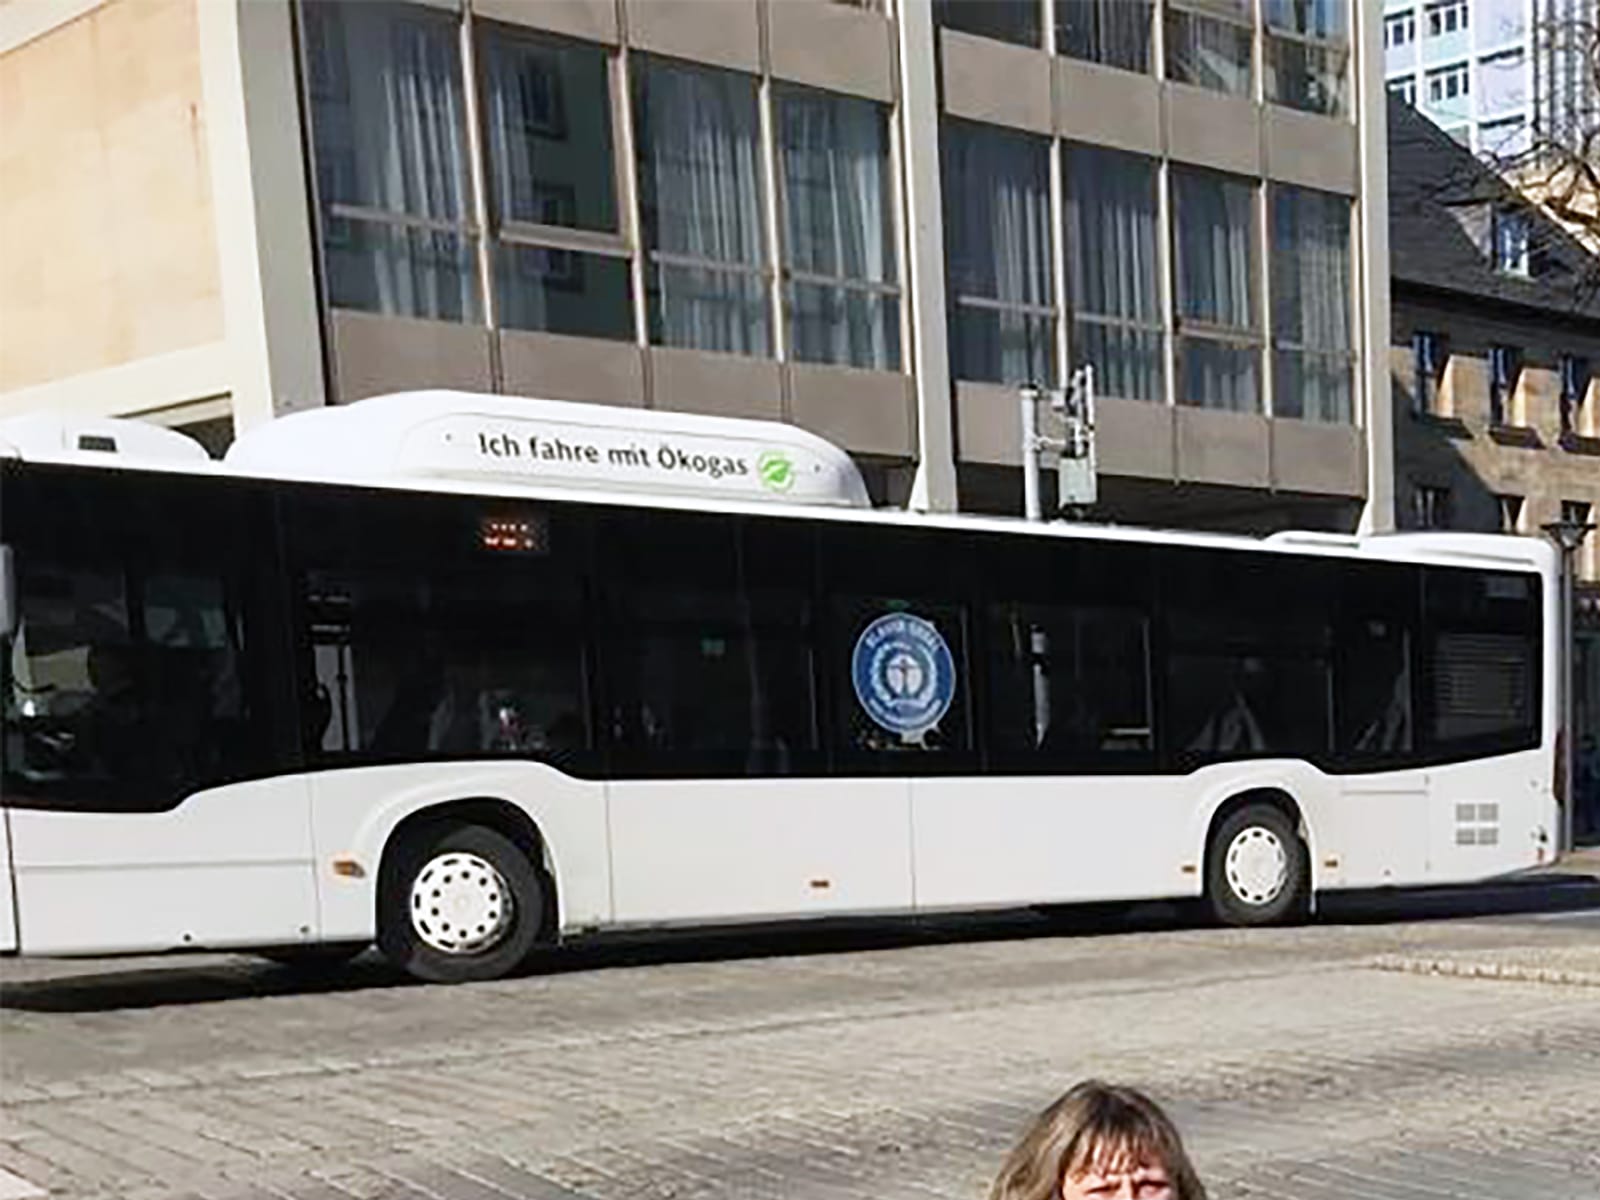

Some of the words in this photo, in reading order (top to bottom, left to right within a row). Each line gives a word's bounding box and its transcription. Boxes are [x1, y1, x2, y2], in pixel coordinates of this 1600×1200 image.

[479, 433, 520, 458] Ich
[530, 437, 599, 463] fahre
[608, 443, 650, 467] mit
[658, 446, 748, 478] Ökogas
